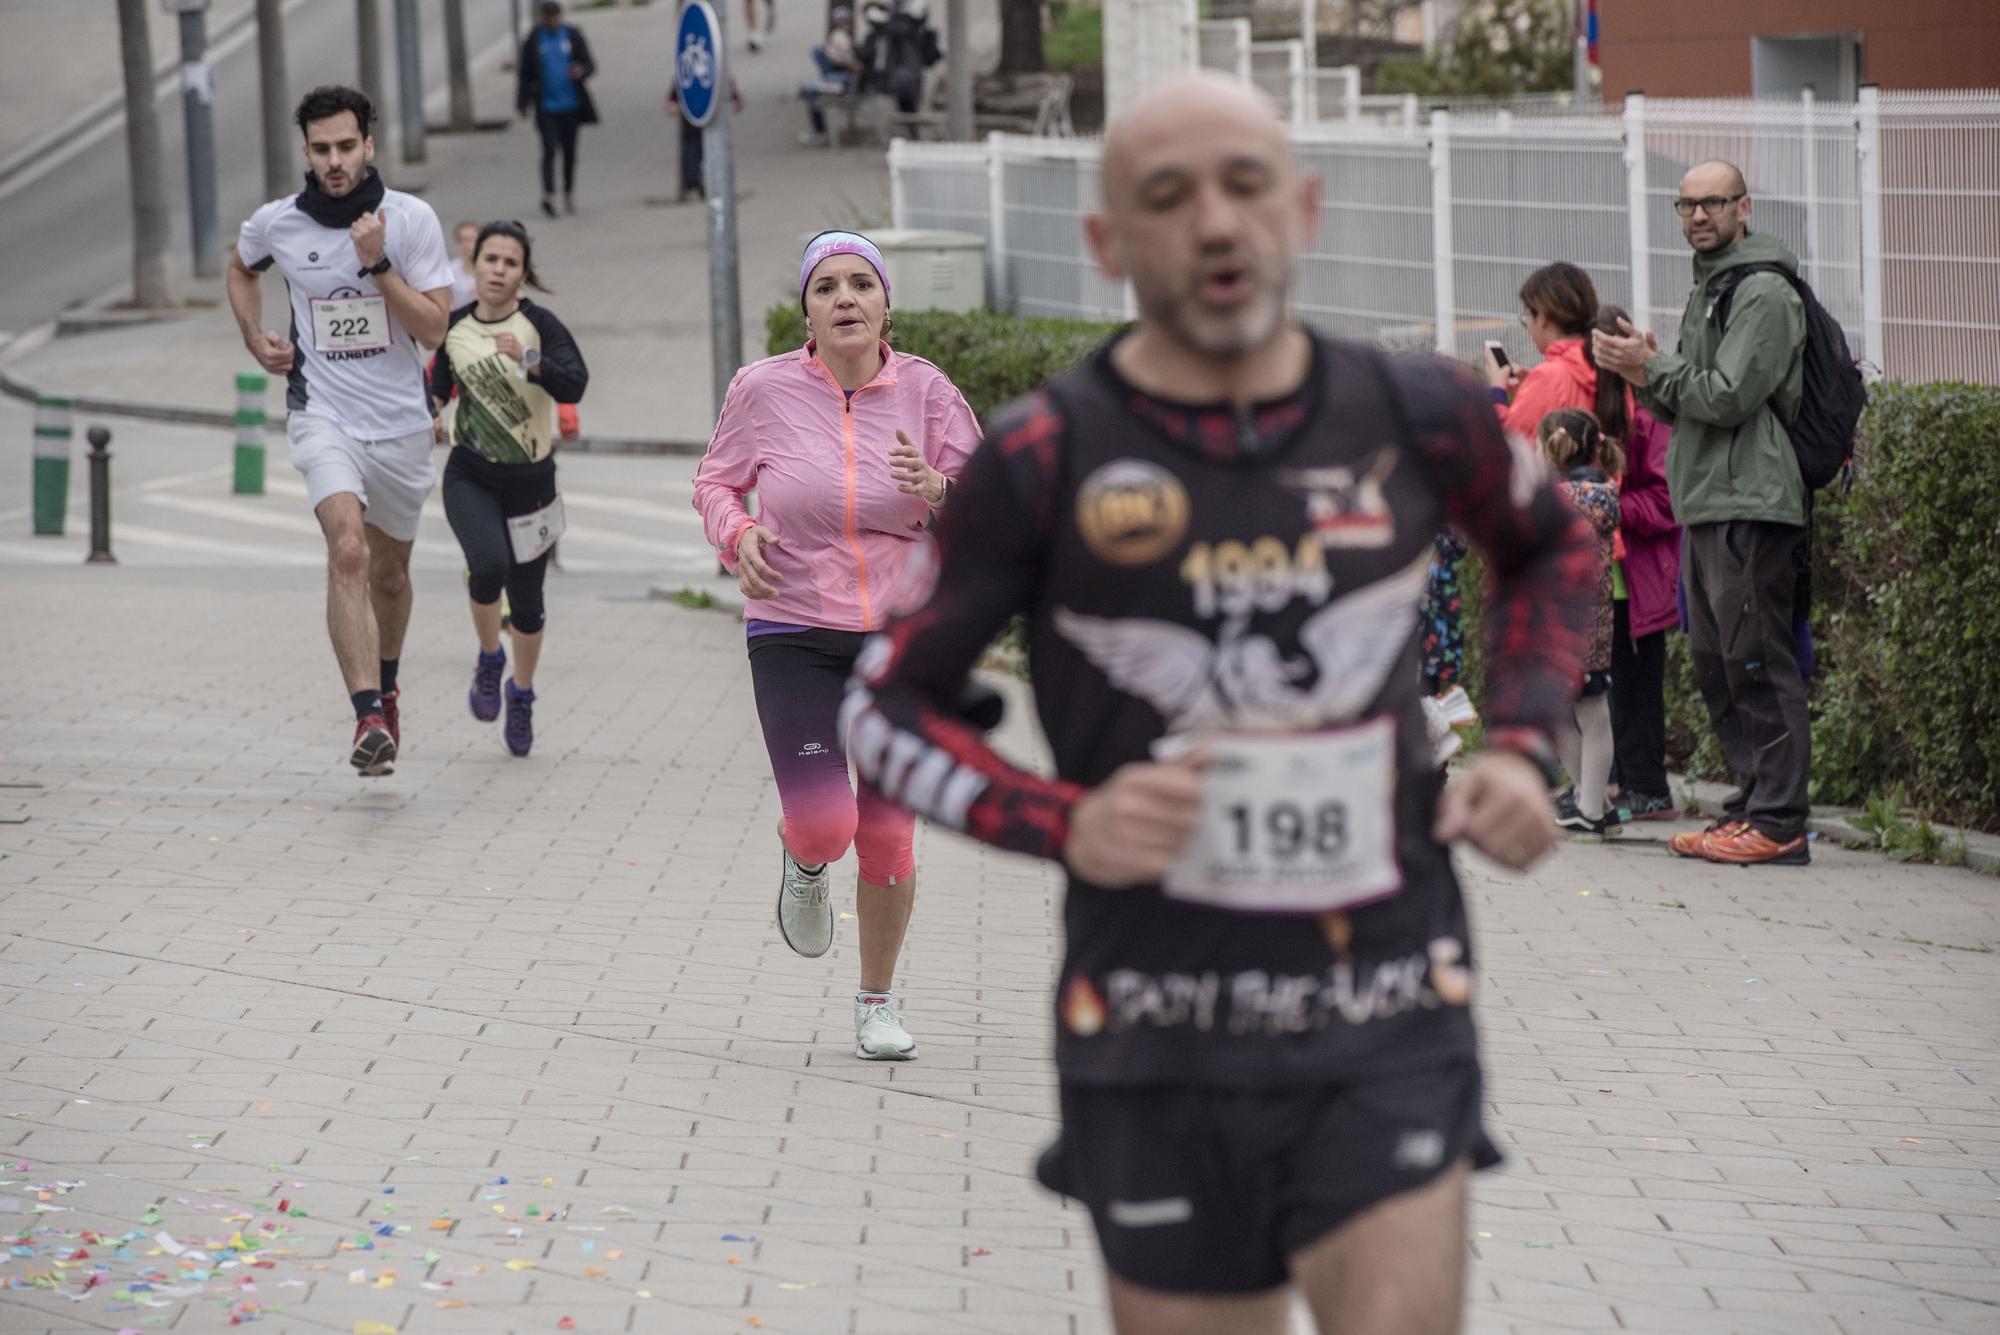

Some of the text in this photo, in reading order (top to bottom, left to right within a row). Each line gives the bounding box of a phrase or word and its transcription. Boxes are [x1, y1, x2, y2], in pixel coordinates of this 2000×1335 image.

[329, 317, 370, 337] 222
[539, 526, 548, 541] 9
[1222, 799, 1350, 861] 198
